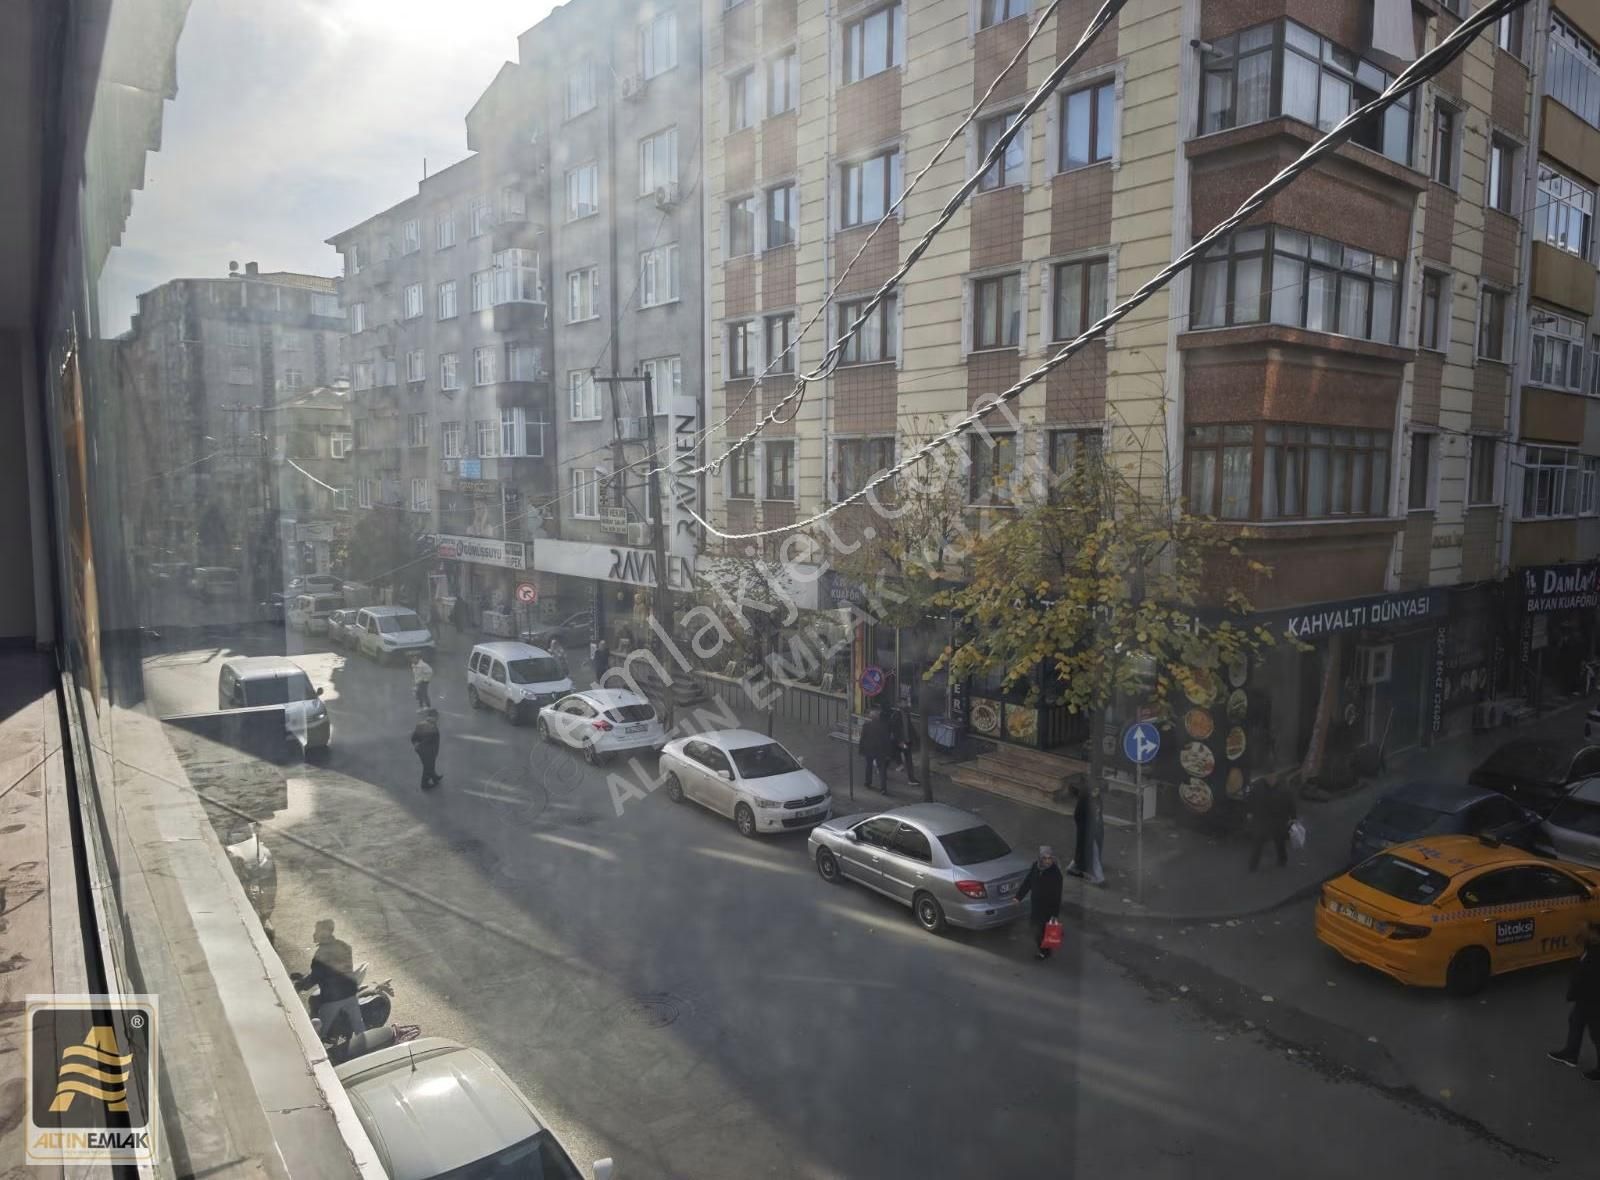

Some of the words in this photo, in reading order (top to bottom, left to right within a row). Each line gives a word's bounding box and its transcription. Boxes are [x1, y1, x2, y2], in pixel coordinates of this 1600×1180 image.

[675, 414, 697, 536] RAVMEN
[1287, 606, 1366, 637] KAHVALTI
[1370, 596, 1430, 623] DÜNYASI
[1527, 597, 1557, 612] BAYAN
[1497, 919, 1533, 937] bitaksi
